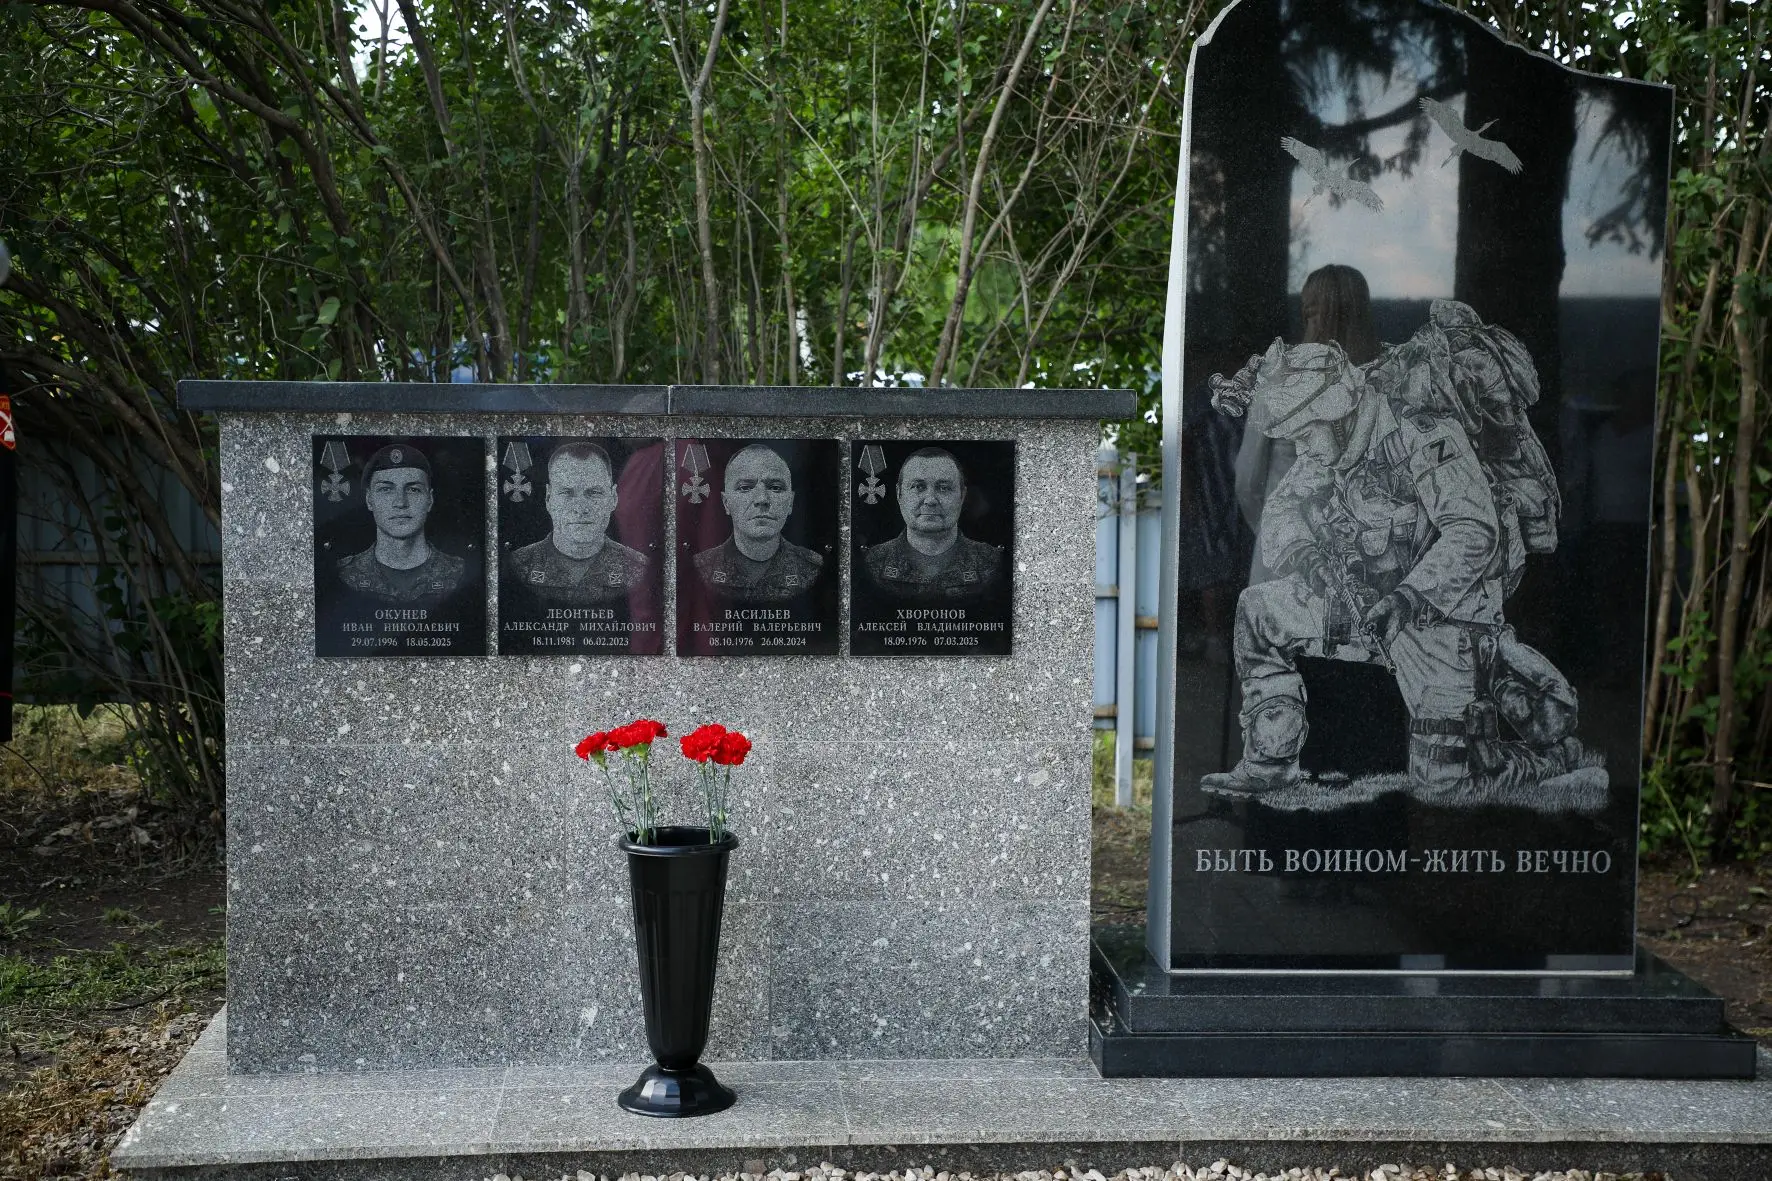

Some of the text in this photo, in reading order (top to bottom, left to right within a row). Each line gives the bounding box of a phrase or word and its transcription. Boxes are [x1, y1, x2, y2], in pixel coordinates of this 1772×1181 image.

[374, 609, 428, 620] ОКУНЕВ
[546, 608, 614, 619] ЛЕОНТЬЕВ
[724, 609, 791, 620] ВАСИЛЬЕВ
[896, 609, 966, 620] ХВОРОНОВ
[342, 622, 460, 632] ИВАН НИКОЛАЕВИЧ
[503, 620, 657, 632] АЛЕКСАНДР МИХАЙЛОВИЧ
[693, 621, 822, 632] ВАЛЕРИЙ ВАЛЕРЬЕВИЧ
[858, 620, 1004, 633] АЛЕКСЕЙ ВЛАДИМИРОВИЧ
[351, 637, 452, 647] 29.07.1996 18.05.2025
[532, 636, 629, 646] 18.11.1981 06.02.2023
[709, 637, 806, 646] 08.10.1976 26.08.2024
[883, 636, 979, 646] 18.09.1976 07.03.2025
[1195, 848, 1274, 873] БЫТЬ
[1515, 849, 1613, 874] ВЕЧНО
